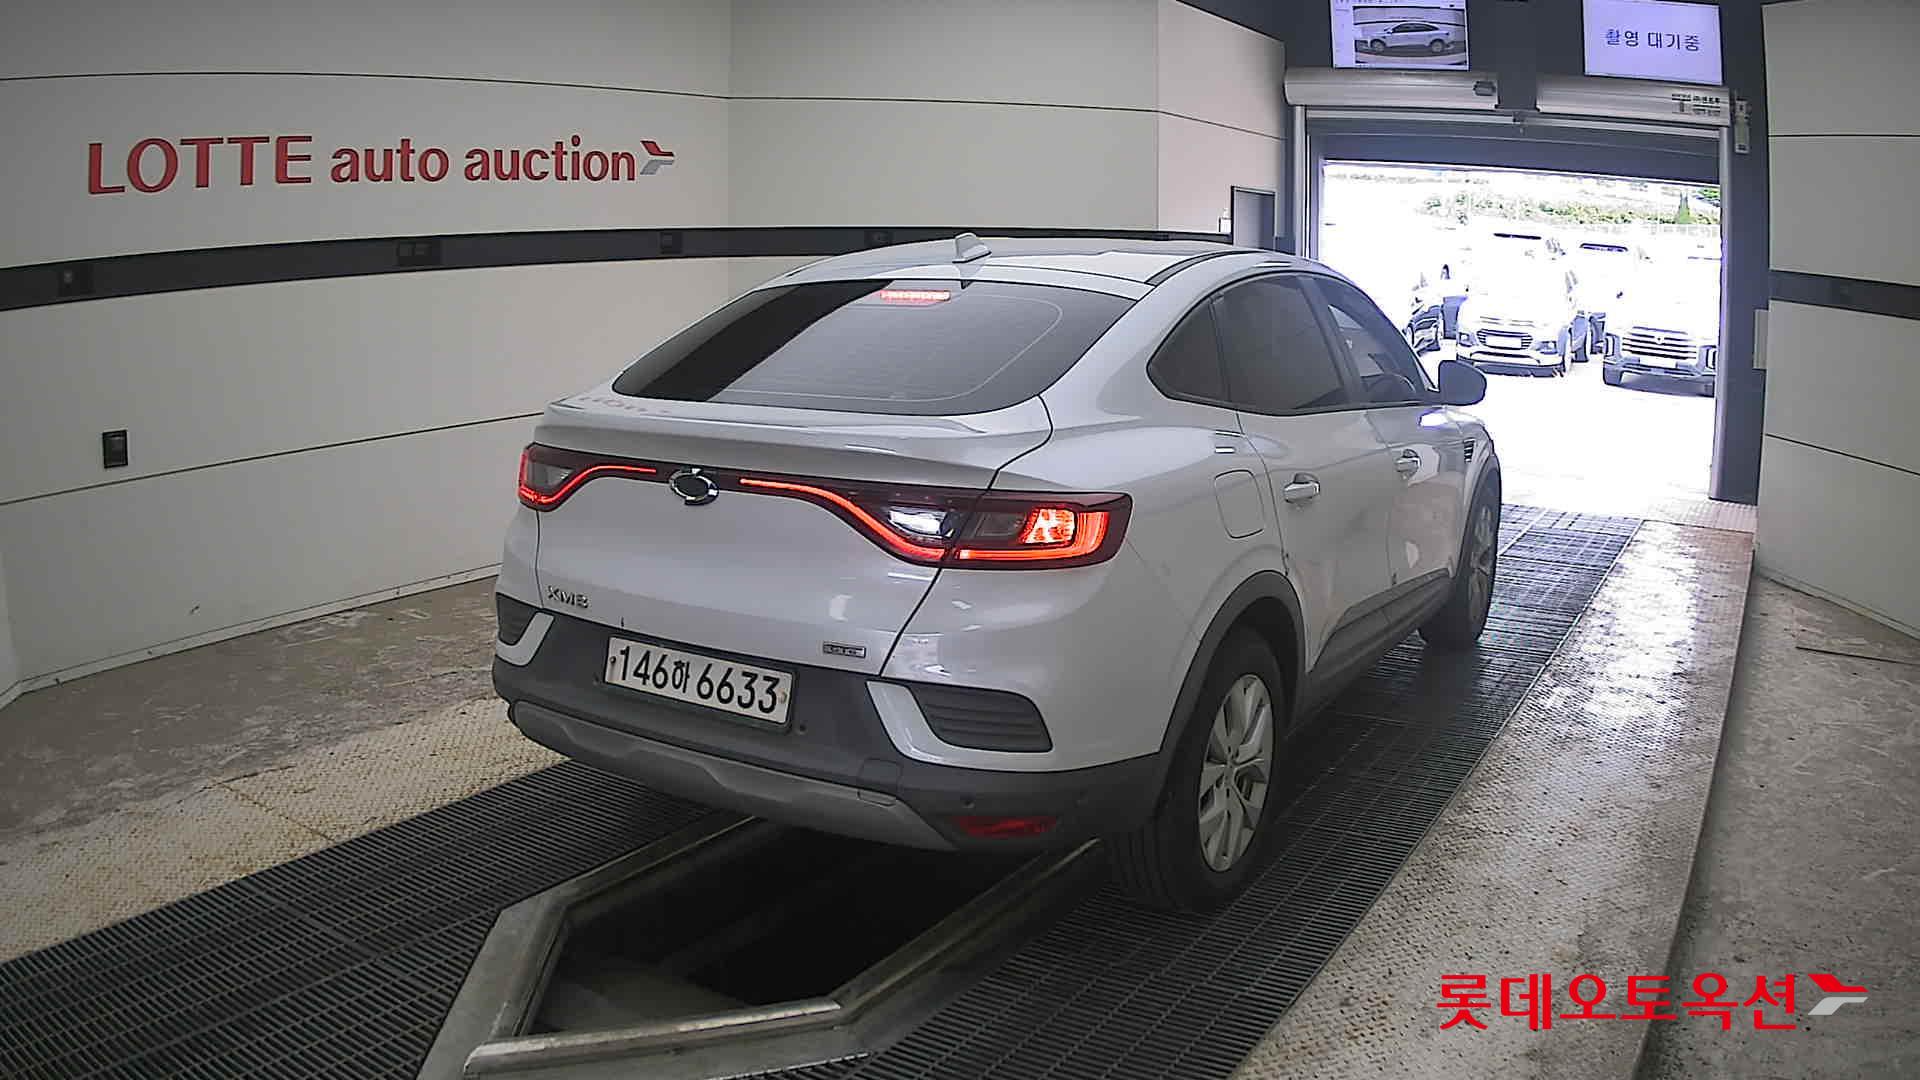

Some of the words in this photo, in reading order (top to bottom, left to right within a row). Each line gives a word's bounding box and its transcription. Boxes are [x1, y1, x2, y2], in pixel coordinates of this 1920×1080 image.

[1606, 28, 1639, 47] 촬영
[1647, 32, 1699, 52] 대기중
[88, 135, 313, 195] LOTTE
[330, 138, 449, 183] auto
[463, 134, 636, 182] auction
[620, 645, 690, 694] 146하
[696, 663, 780, 714] 6633
